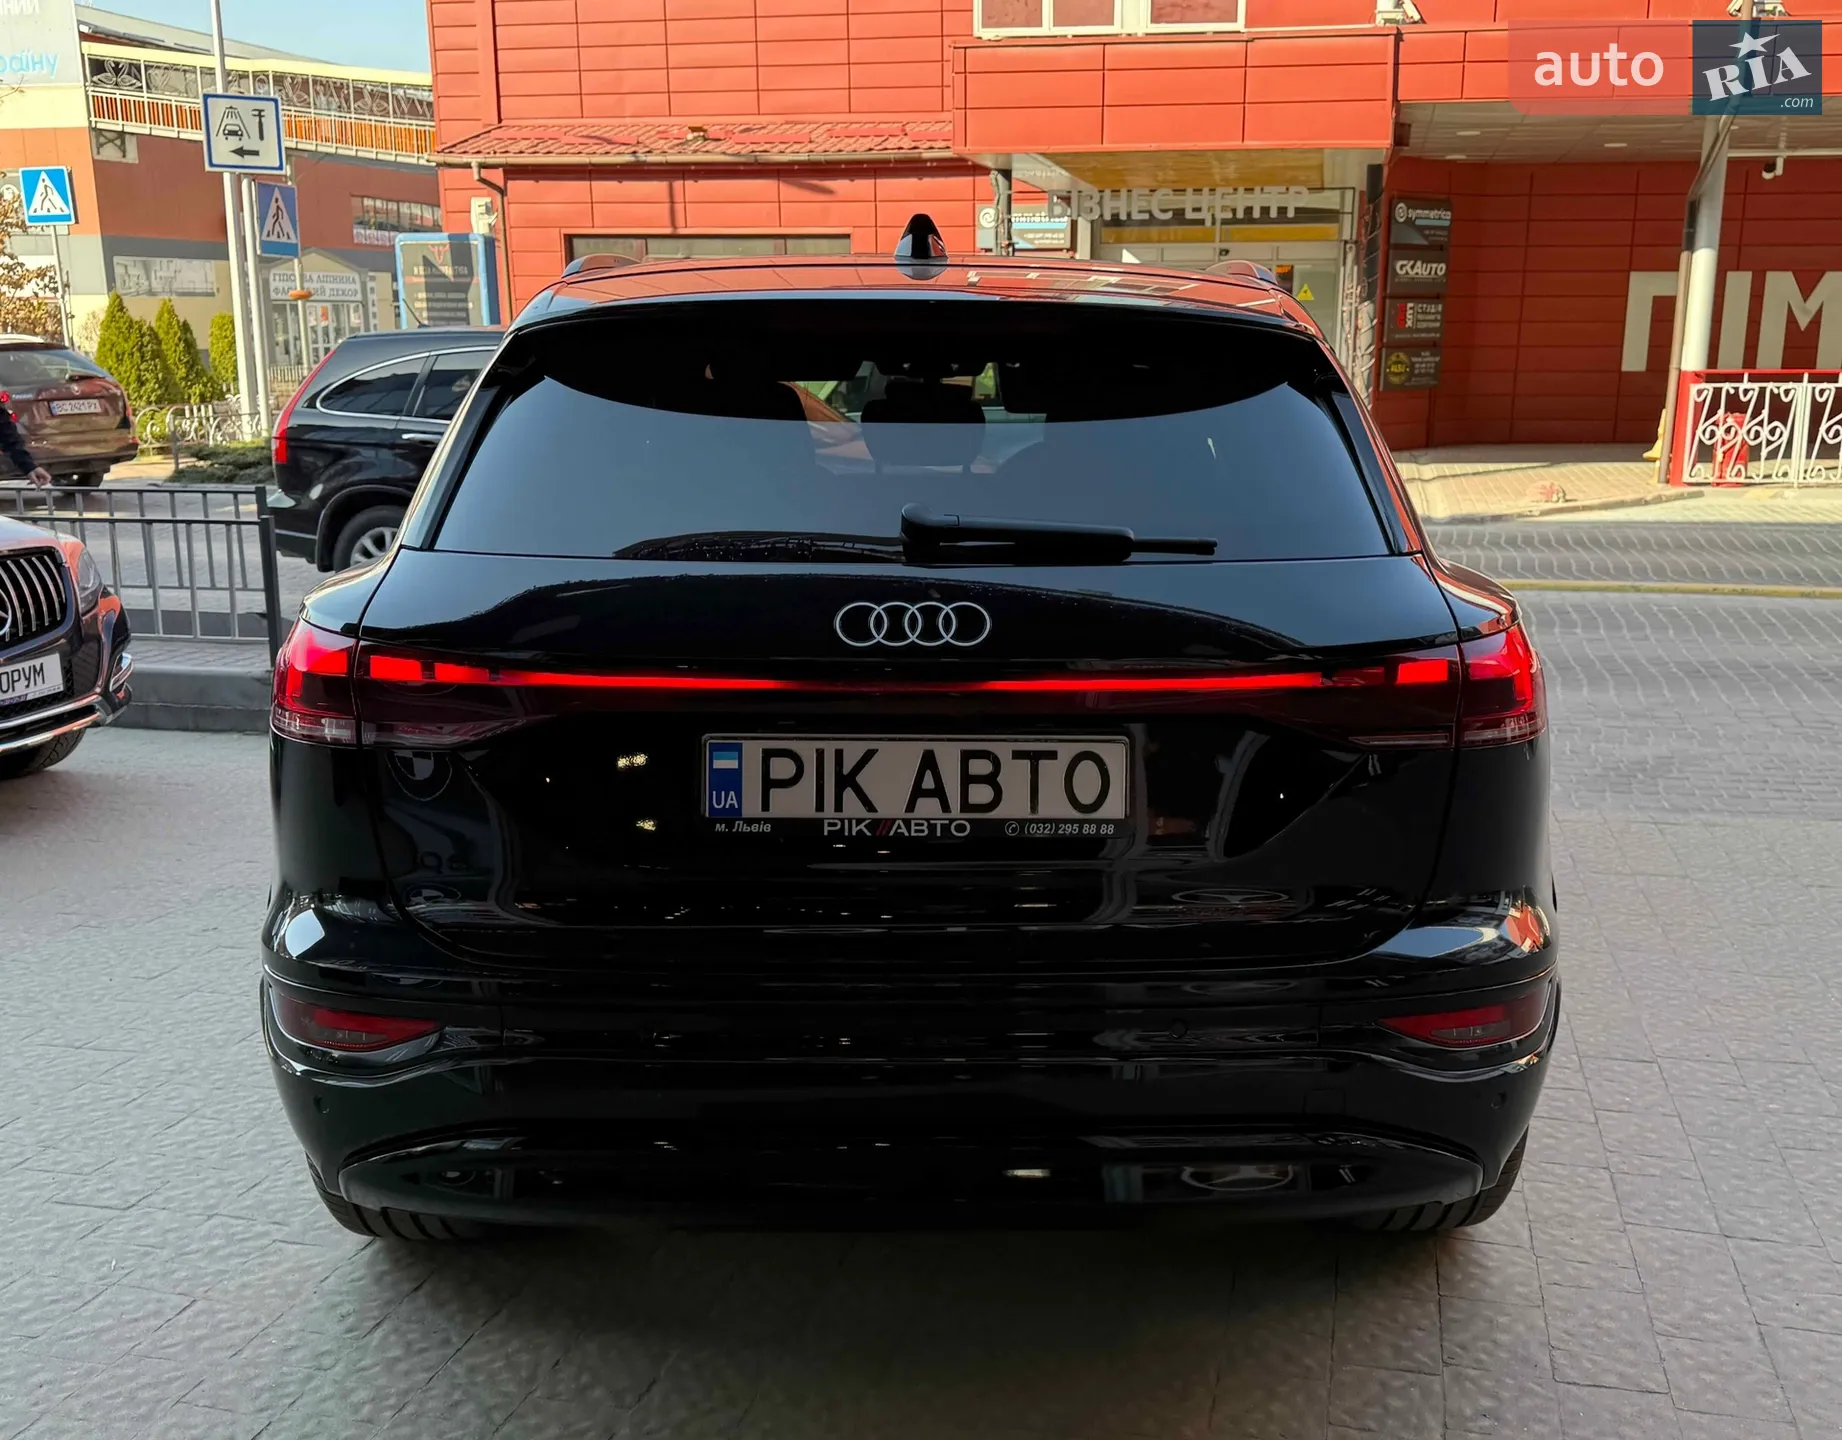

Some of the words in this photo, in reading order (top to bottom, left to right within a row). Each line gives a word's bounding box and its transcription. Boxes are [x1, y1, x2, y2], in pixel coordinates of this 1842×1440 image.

[1048, 187, 1173, 221] БІЗНЕС
[1185, 185, 1309, 227] ЦЕНТР
[273, 273, 313, 283] ГІПСВА
[712, 790, 738, 809] UA
[732, 821, 771, 833] Львів
[1024, 822, 1056, 834] (032)
[1058, 823, 1079, 834] 295
[1082, 824, 1097, 834] 88
[1100, 824, 1114, 834] 88
